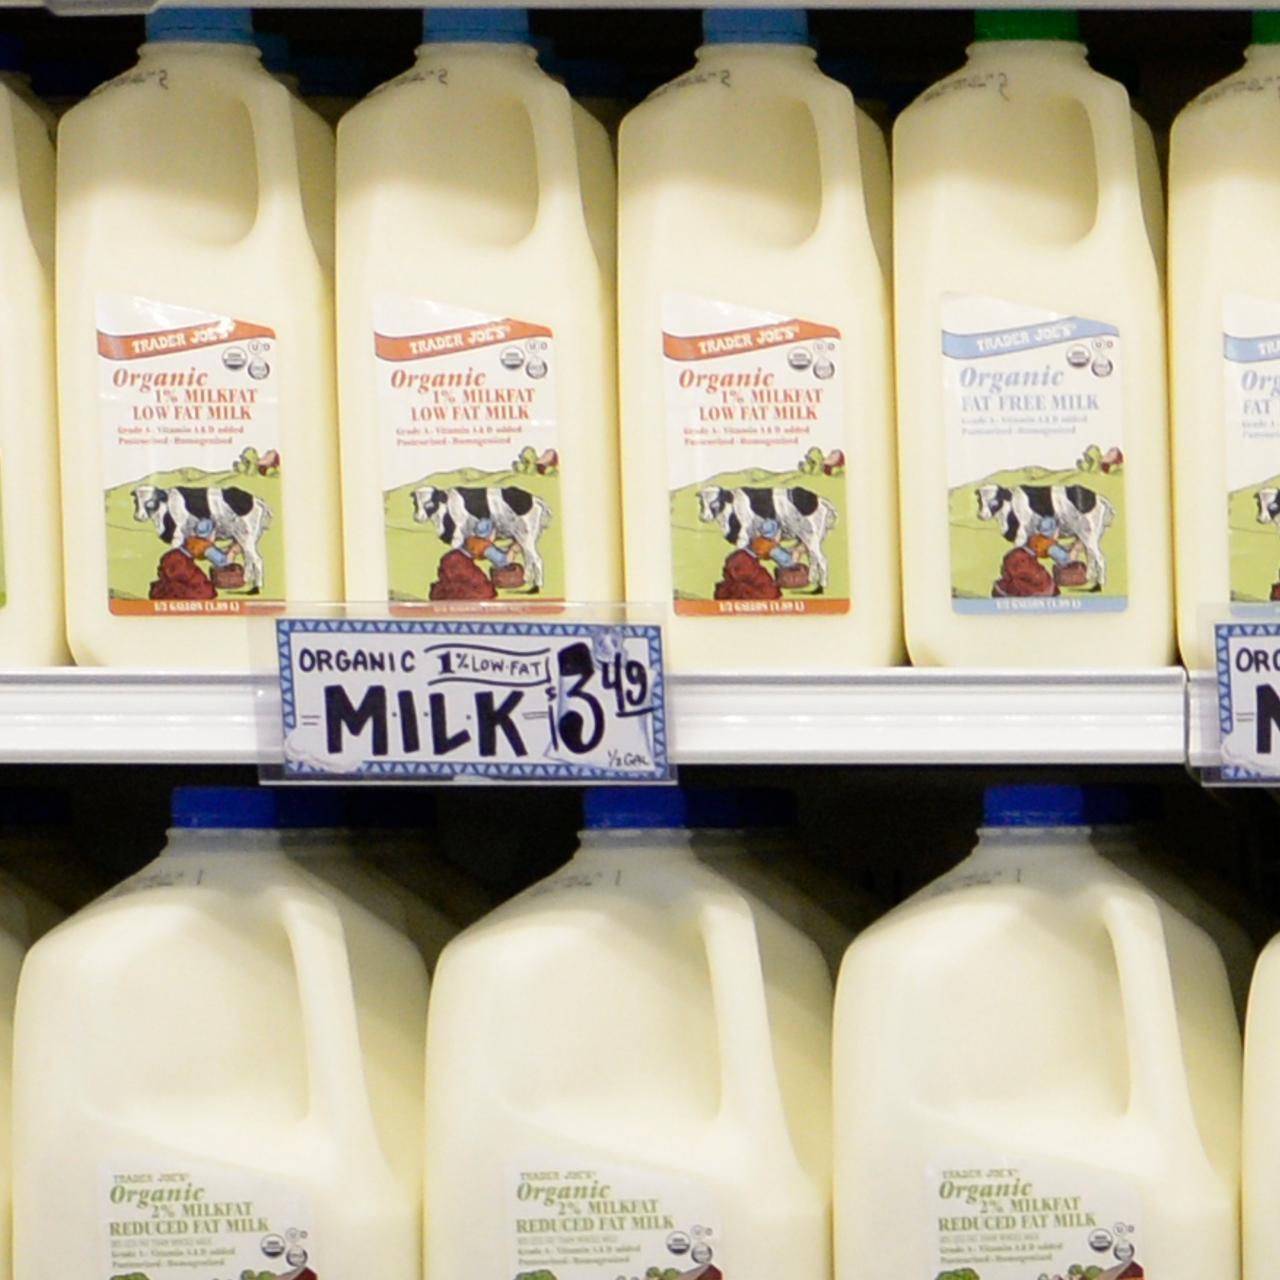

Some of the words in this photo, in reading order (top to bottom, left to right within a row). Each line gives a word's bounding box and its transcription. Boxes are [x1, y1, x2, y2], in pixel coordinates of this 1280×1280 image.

[409, 333, 464, 354] TRADER
[391, 367, 486, 394] Organic
[433, 390, 456, 404] 1%
[463, 388, 536, 403] MILKFAT
[411, 407, 448, 421] LOW
[453, 406, 481, 420] FAT
[486, 404, 530, 420] MILK
[1243, 399, 1274, 415] FAT
[299, 649, 416, 673] ORGANIC
[437, 651, 469, 674] 1%
[110, 1182, 205, 1209] Organic
[151, 1203, 175, 1218] 2%
[182, 1201, 254, 1217] MILKFAT
[109, 1220, 188, 1236] REDUCED
[193, 1219, 221, 1235] FAT
[226, 1218, 270, 1233] MILK
